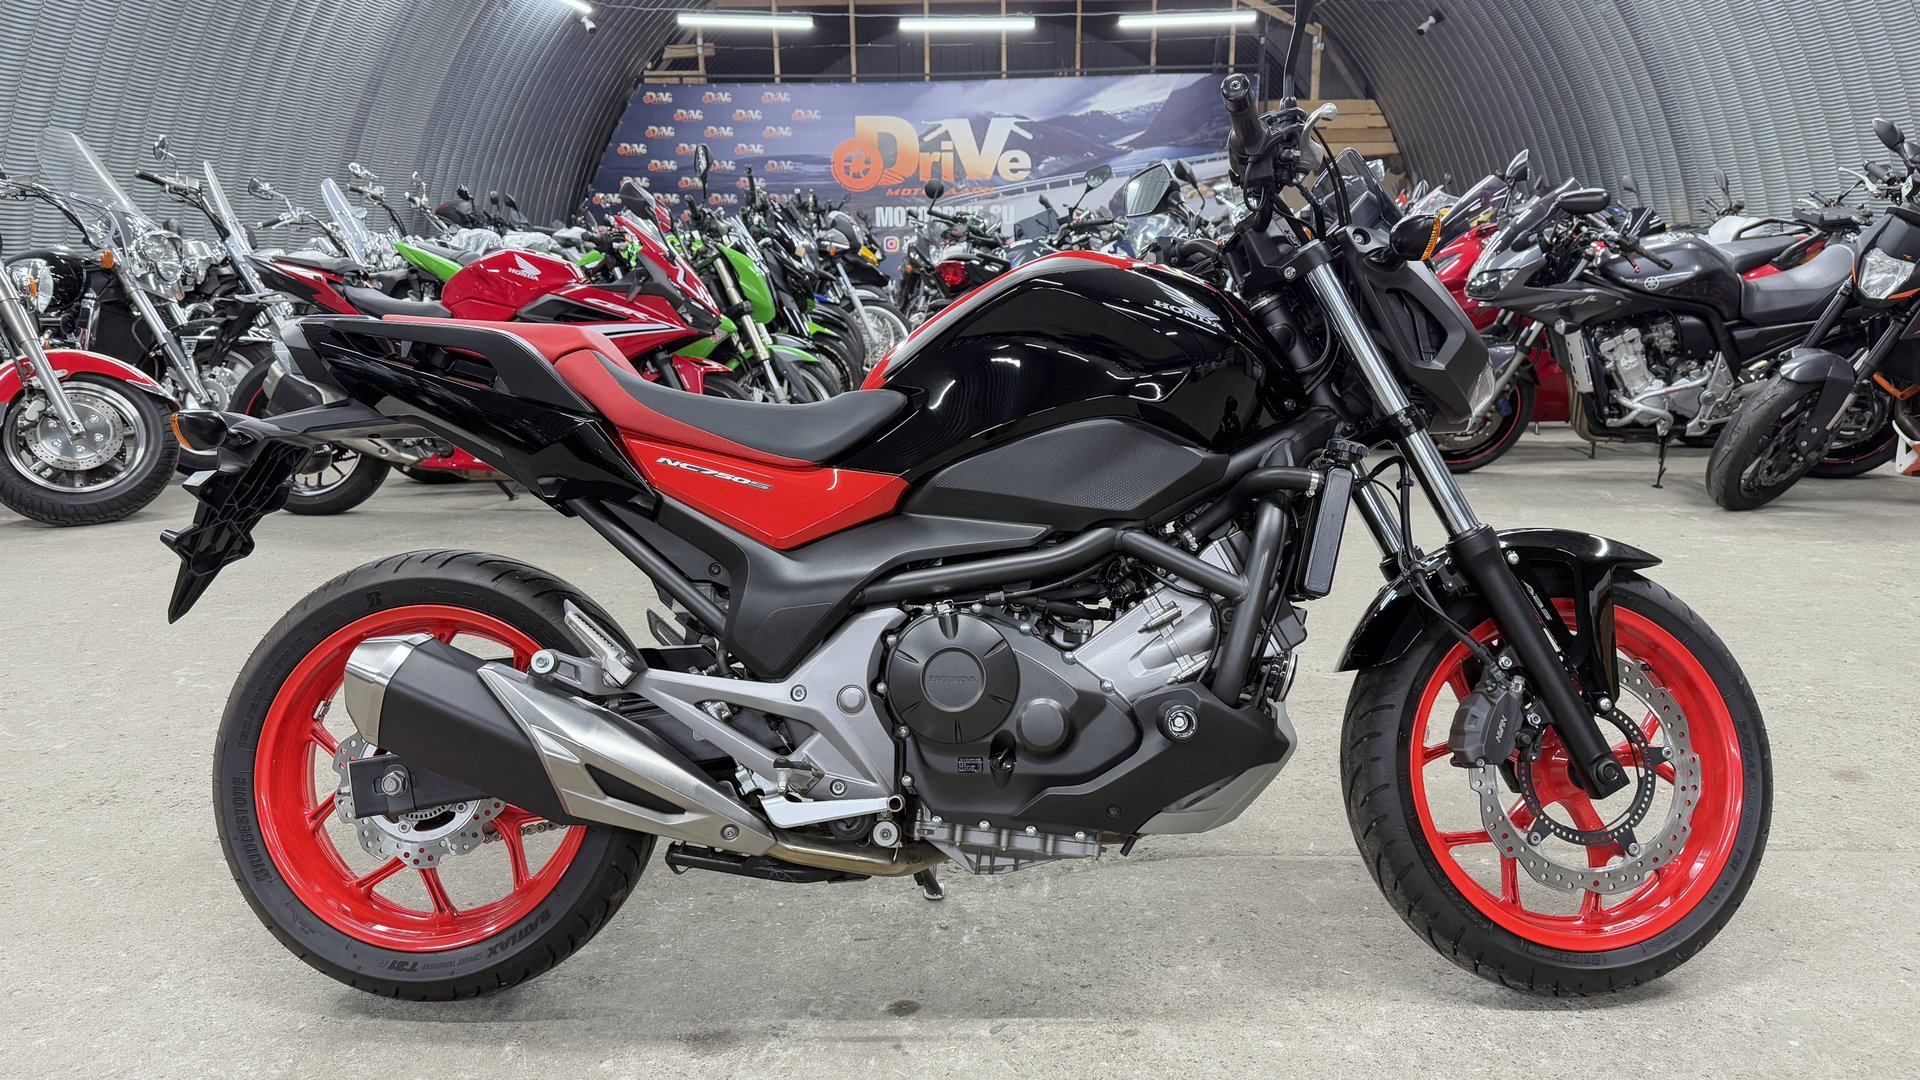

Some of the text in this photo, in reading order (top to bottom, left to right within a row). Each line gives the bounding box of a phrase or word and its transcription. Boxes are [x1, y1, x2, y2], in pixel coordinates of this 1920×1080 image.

[508, 267, 540, 282] HONDA
[1153, 299, 1227, 333] HONDA
[656, 457, 774, 491] NC750S
[928, 675, 977, 683] HONDA
[232, 776, 272, 882] BRIDGESTONE
[487, 908, 552, 959] BATTLAX
